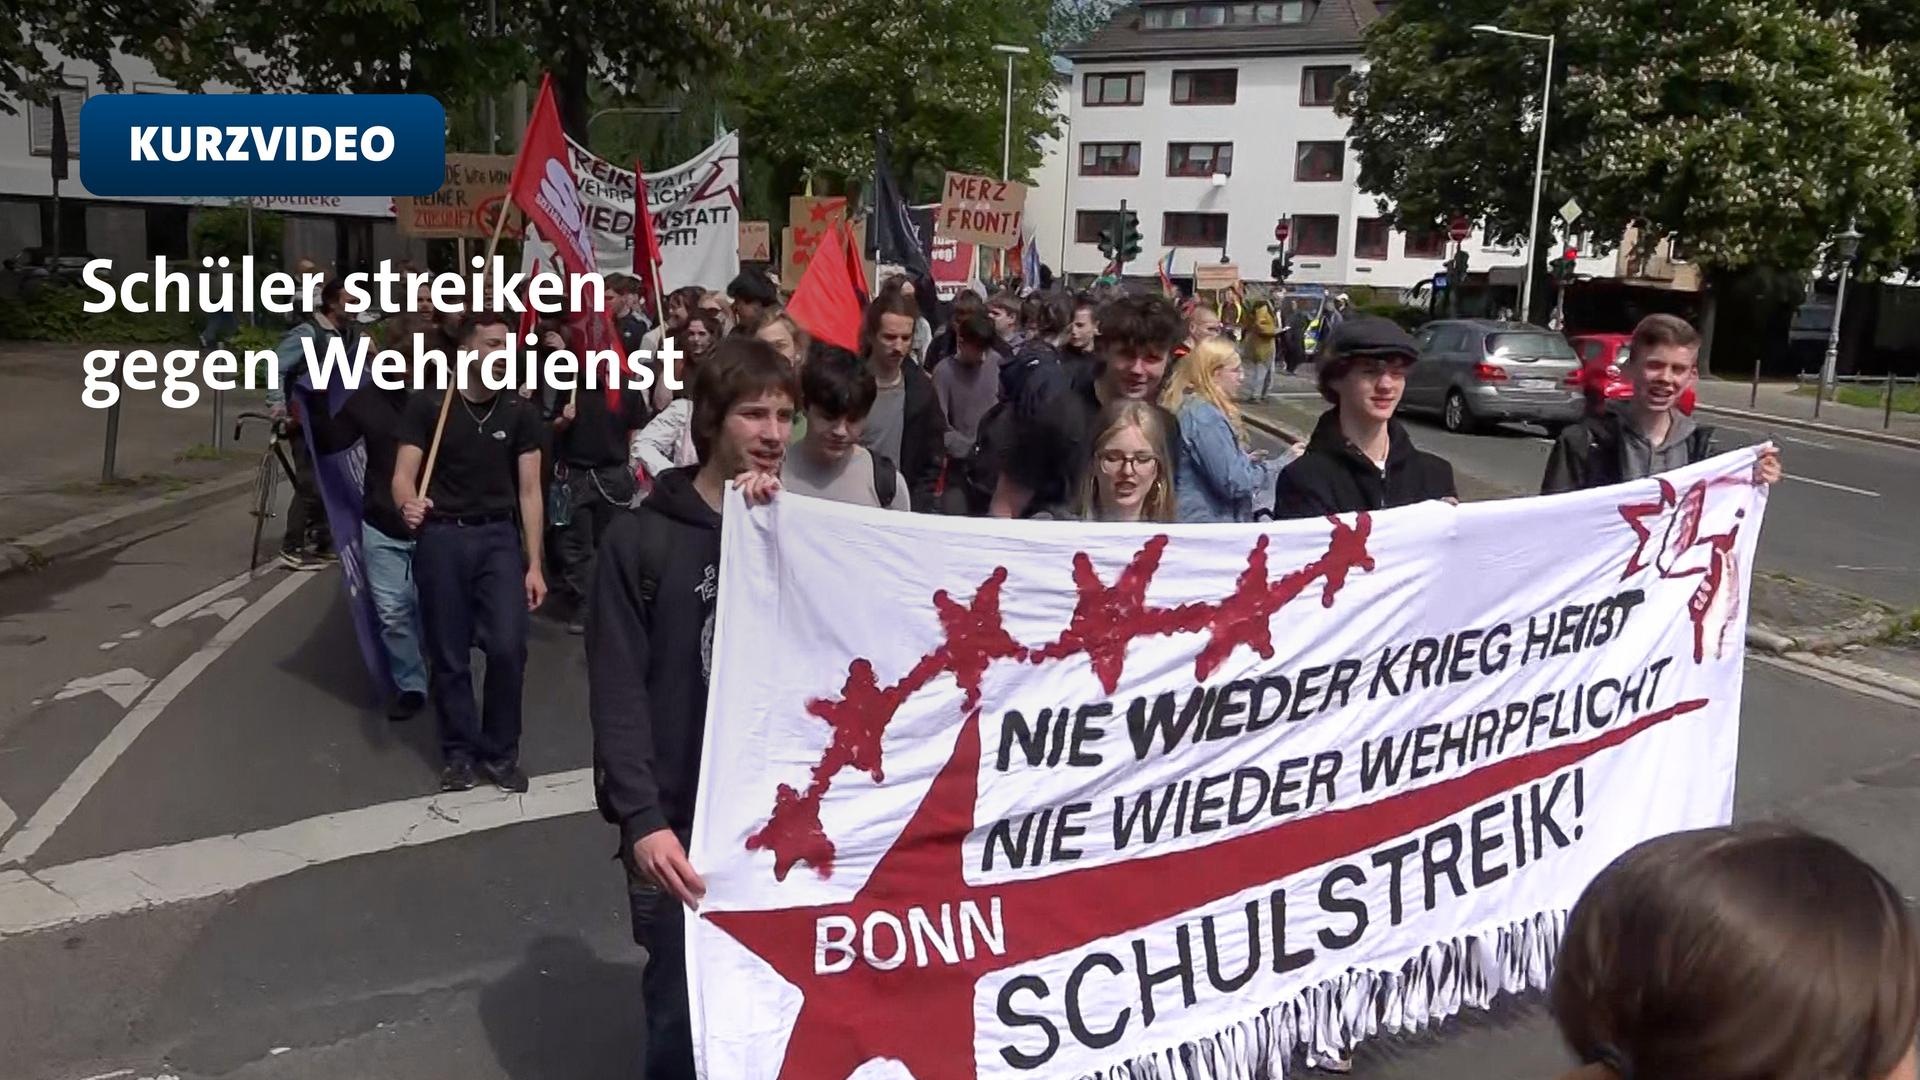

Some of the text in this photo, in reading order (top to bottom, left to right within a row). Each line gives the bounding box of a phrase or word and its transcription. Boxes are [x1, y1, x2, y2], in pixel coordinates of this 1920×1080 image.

[574, 148, 634, 192] REIK
[577, 177, 699, 206] WEHRPLICHT
[948, 177, 1008, 202] MERZ
[584, 202, 731, 234] IEDN STATT
[946, 207, 1021, 236] FRONT!
[625, 228, 698, 251] POFIT!
[997, 702, 1113, 772] NIE
[1127, 659, 1361, 761] WIEDER
[1369, 623, 1511, 700] KRIEG
[981, 656, 1673, 872] NIE WIEDER WEHRPFLICHT
[813, 897, 1006, 976] BONN
[998, 767, 1585, 1070] SCHULSTREIK!
